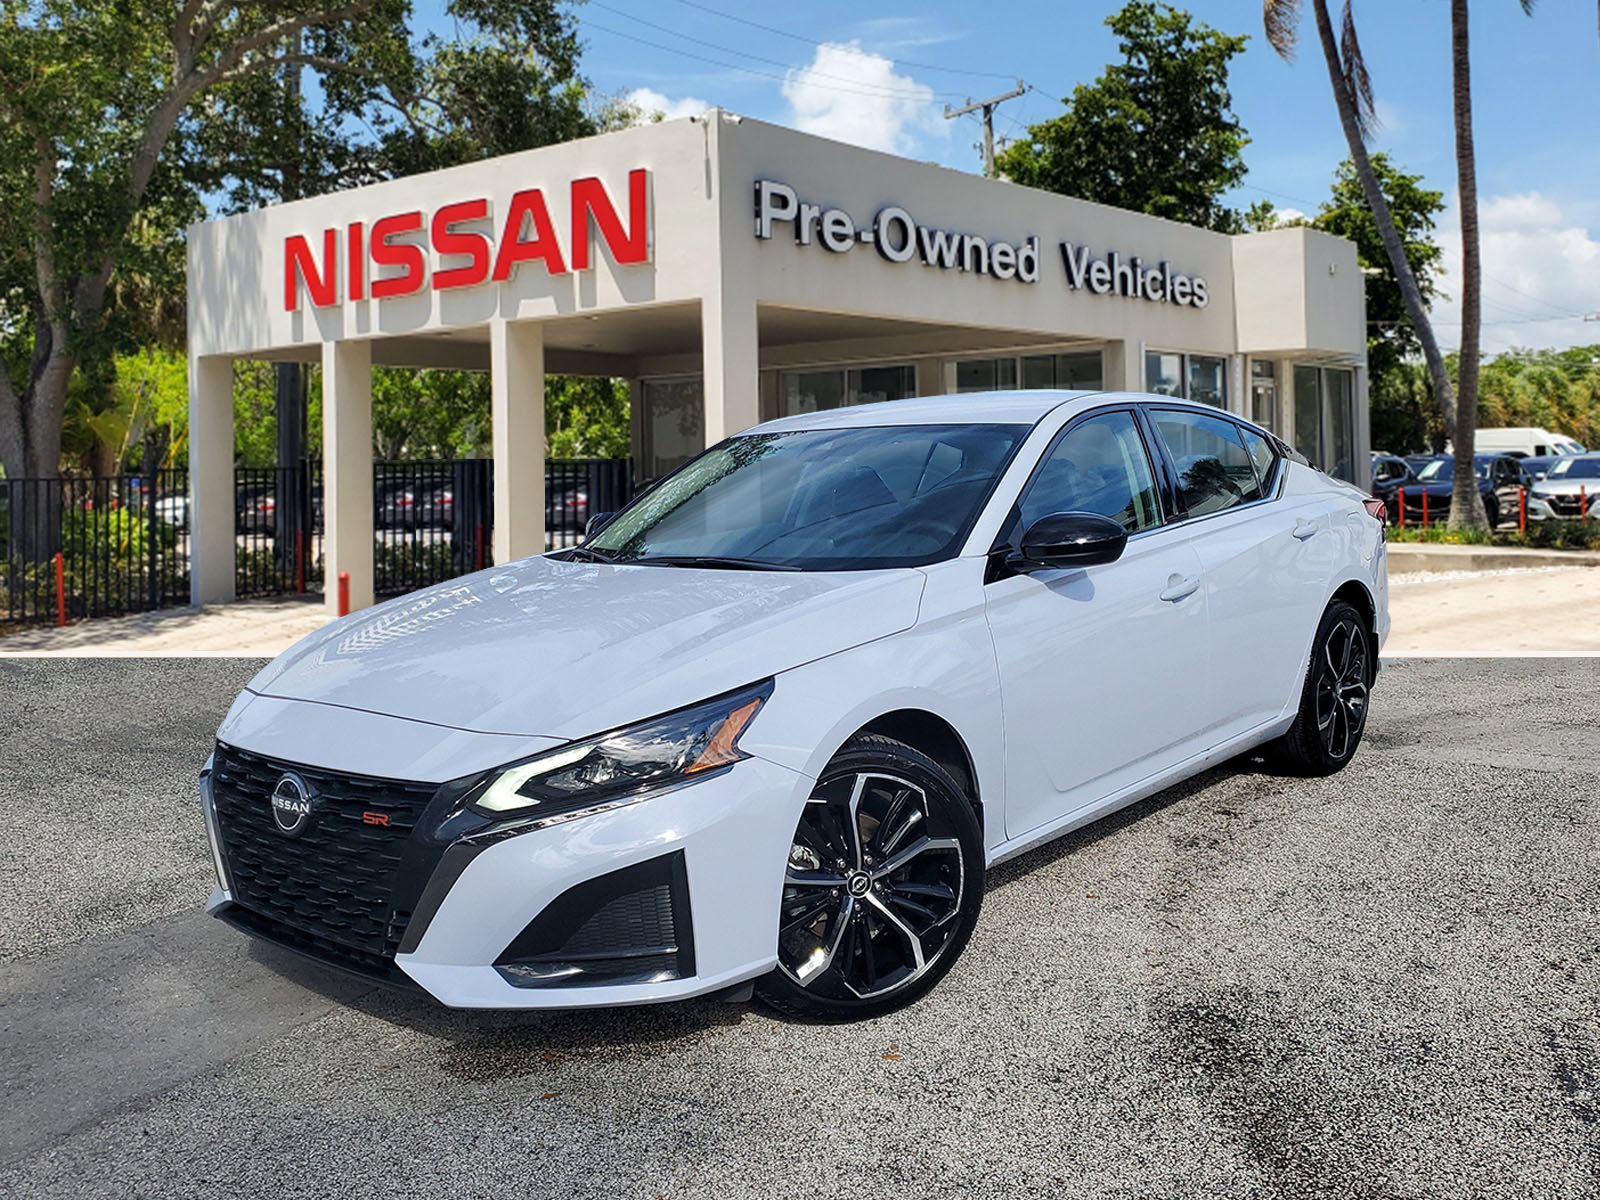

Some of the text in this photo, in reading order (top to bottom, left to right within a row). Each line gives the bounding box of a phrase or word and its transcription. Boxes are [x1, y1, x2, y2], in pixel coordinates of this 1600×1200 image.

[285, 168, 647, 312] NISSAN
[755, 179, 1209, 309] Pre-Owned Vehicles
[363, 811, 389, 825] SR
